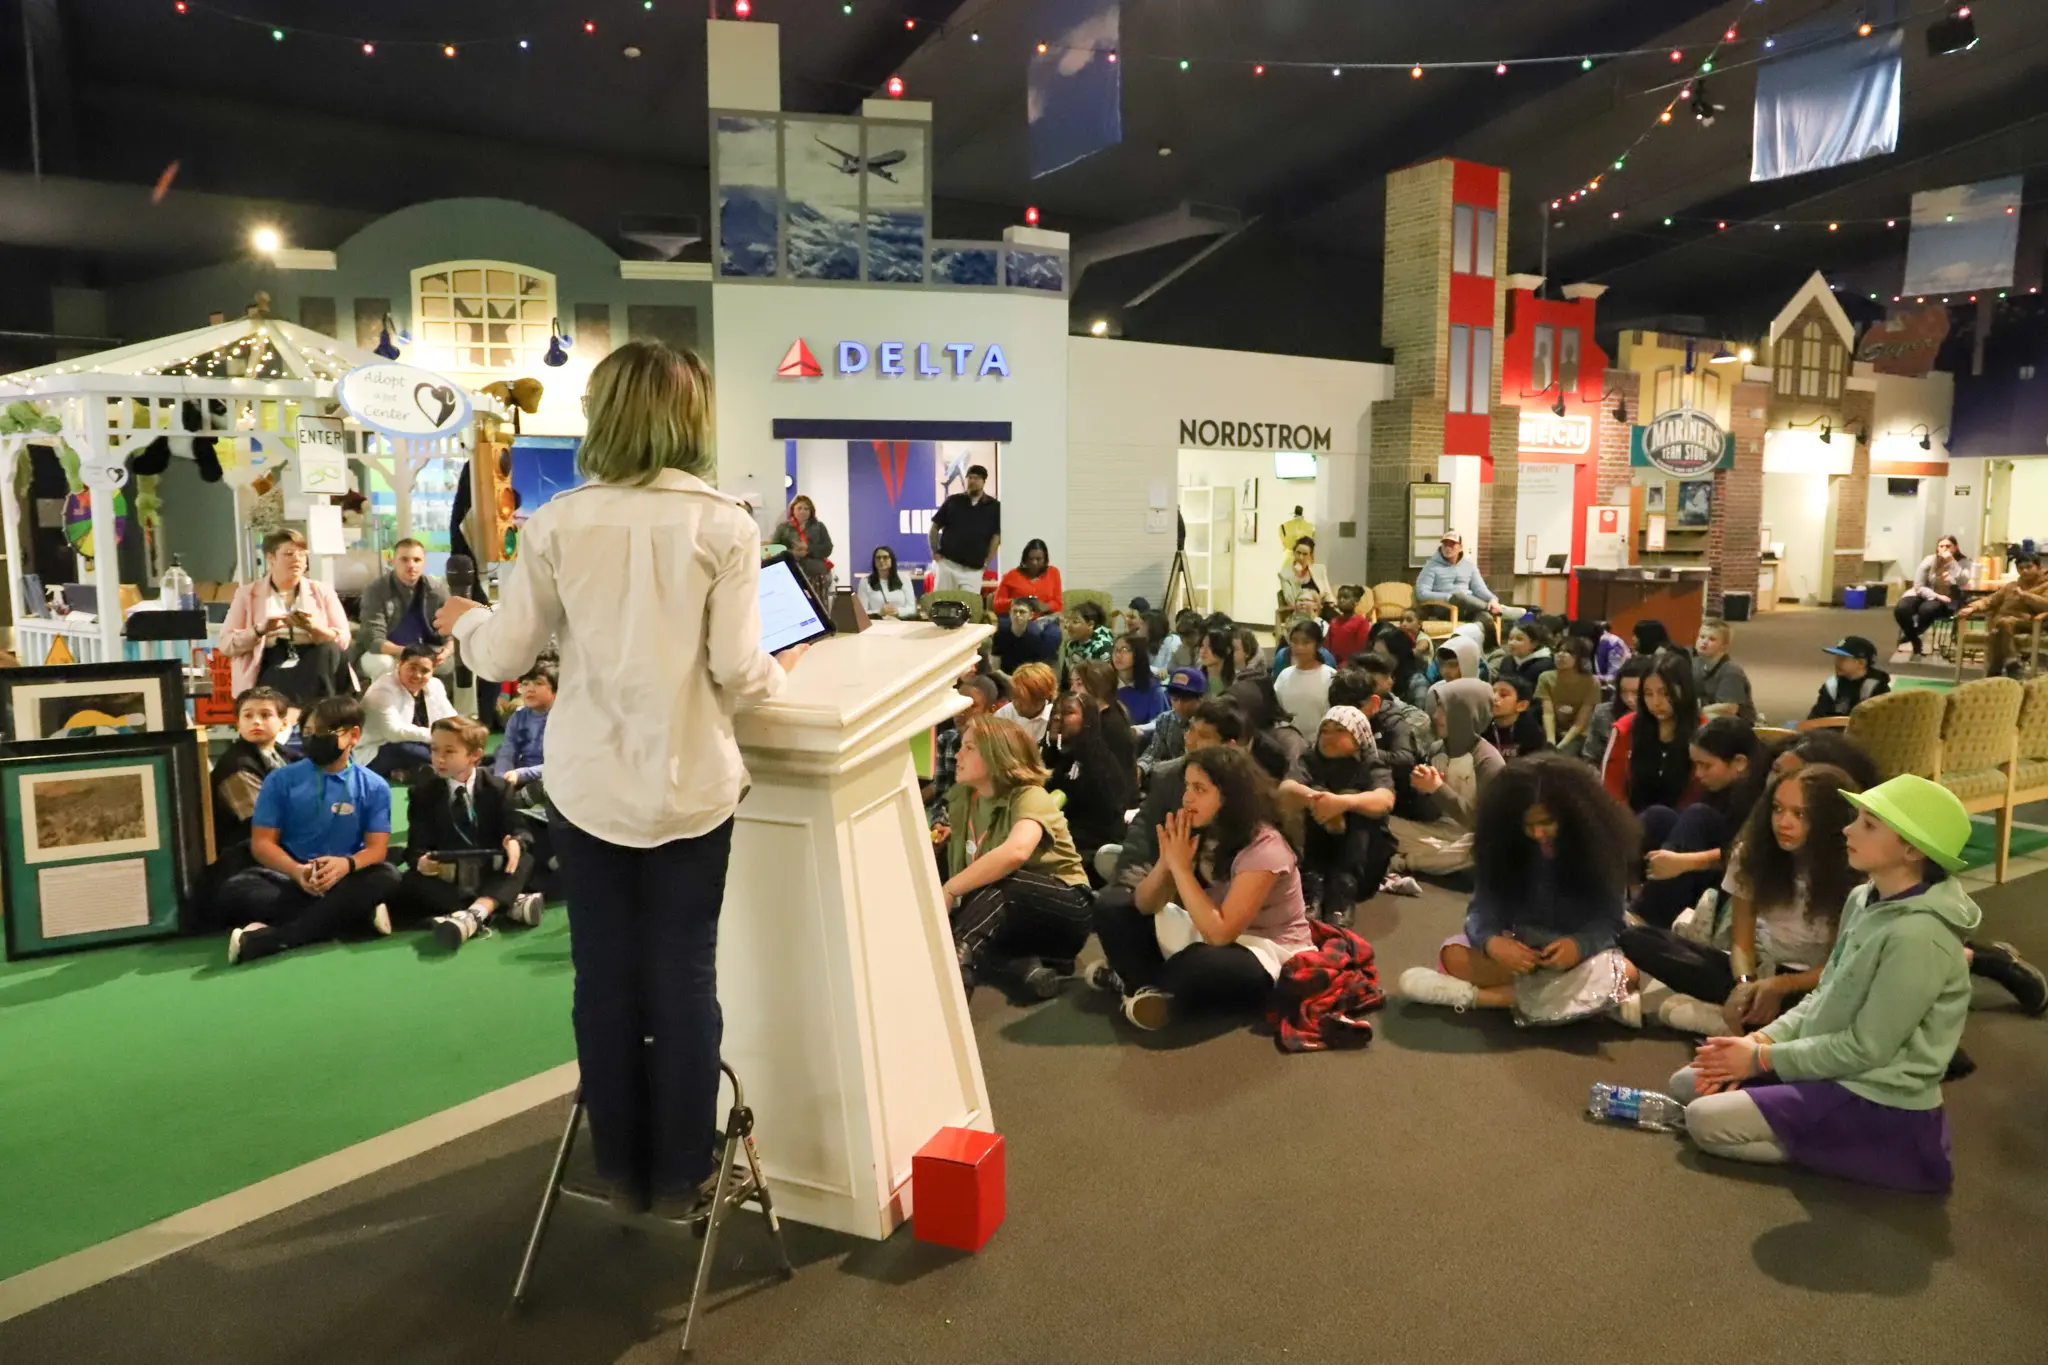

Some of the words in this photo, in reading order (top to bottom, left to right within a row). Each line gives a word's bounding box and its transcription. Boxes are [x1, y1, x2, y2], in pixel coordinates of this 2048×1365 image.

[838, 341, 1010, 377] DELTA
[363, 371, 407, 390] Adopt
[363, 404, 411, 421] Center
[299, 429, 342, 445] ENTER
[1180, 419, 1331, 450] NORDSTROM
[1650, 419, 1721, 453] MARINERS
